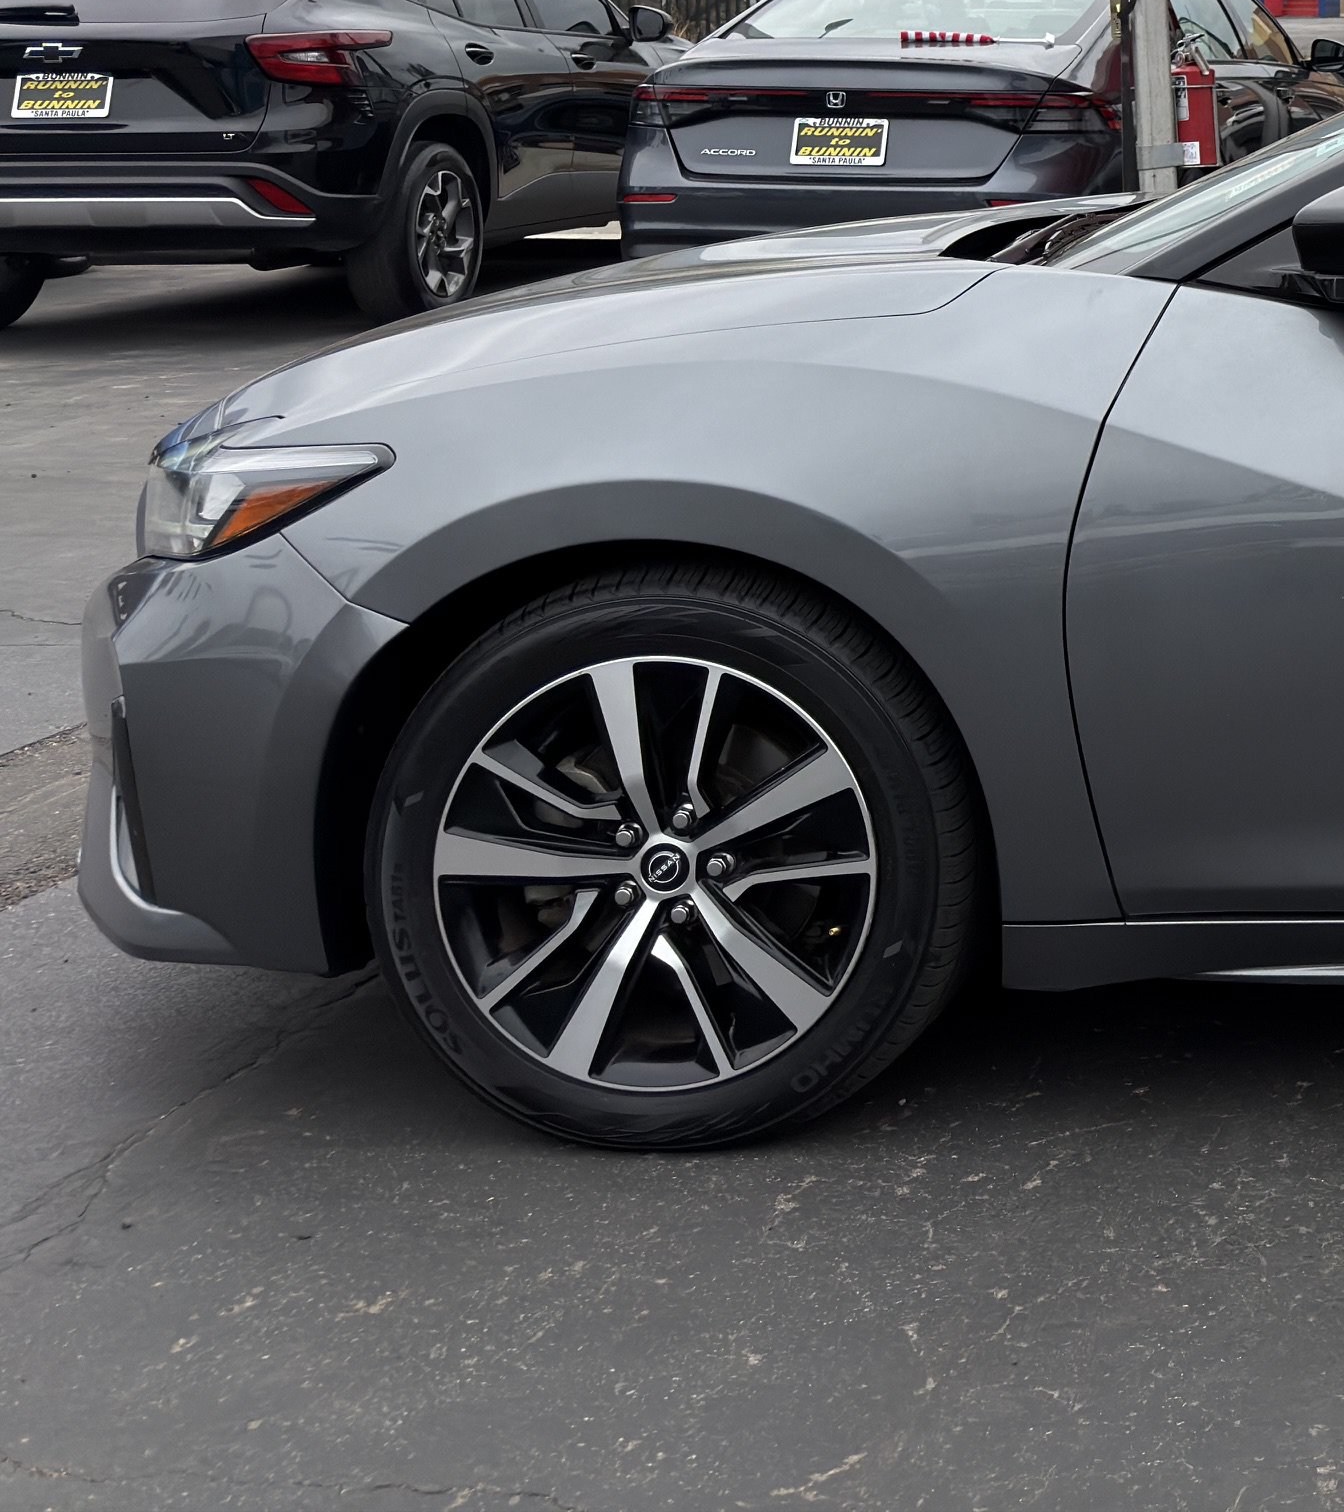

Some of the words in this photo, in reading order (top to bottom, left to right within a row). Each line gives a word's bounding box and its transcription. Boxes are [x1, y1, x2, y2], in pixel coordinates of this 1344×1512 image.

[23, 81, 107, 89] RUNNIN'
[19, 100, 101, 109] BUNNIN
[800, 127, 882, 137] RUNNIN'
[700, 148, 756, 156] ACCORD
[798, 147, 876, 156] BUNNIN
[648, 853, 680, 883] NISSAN
